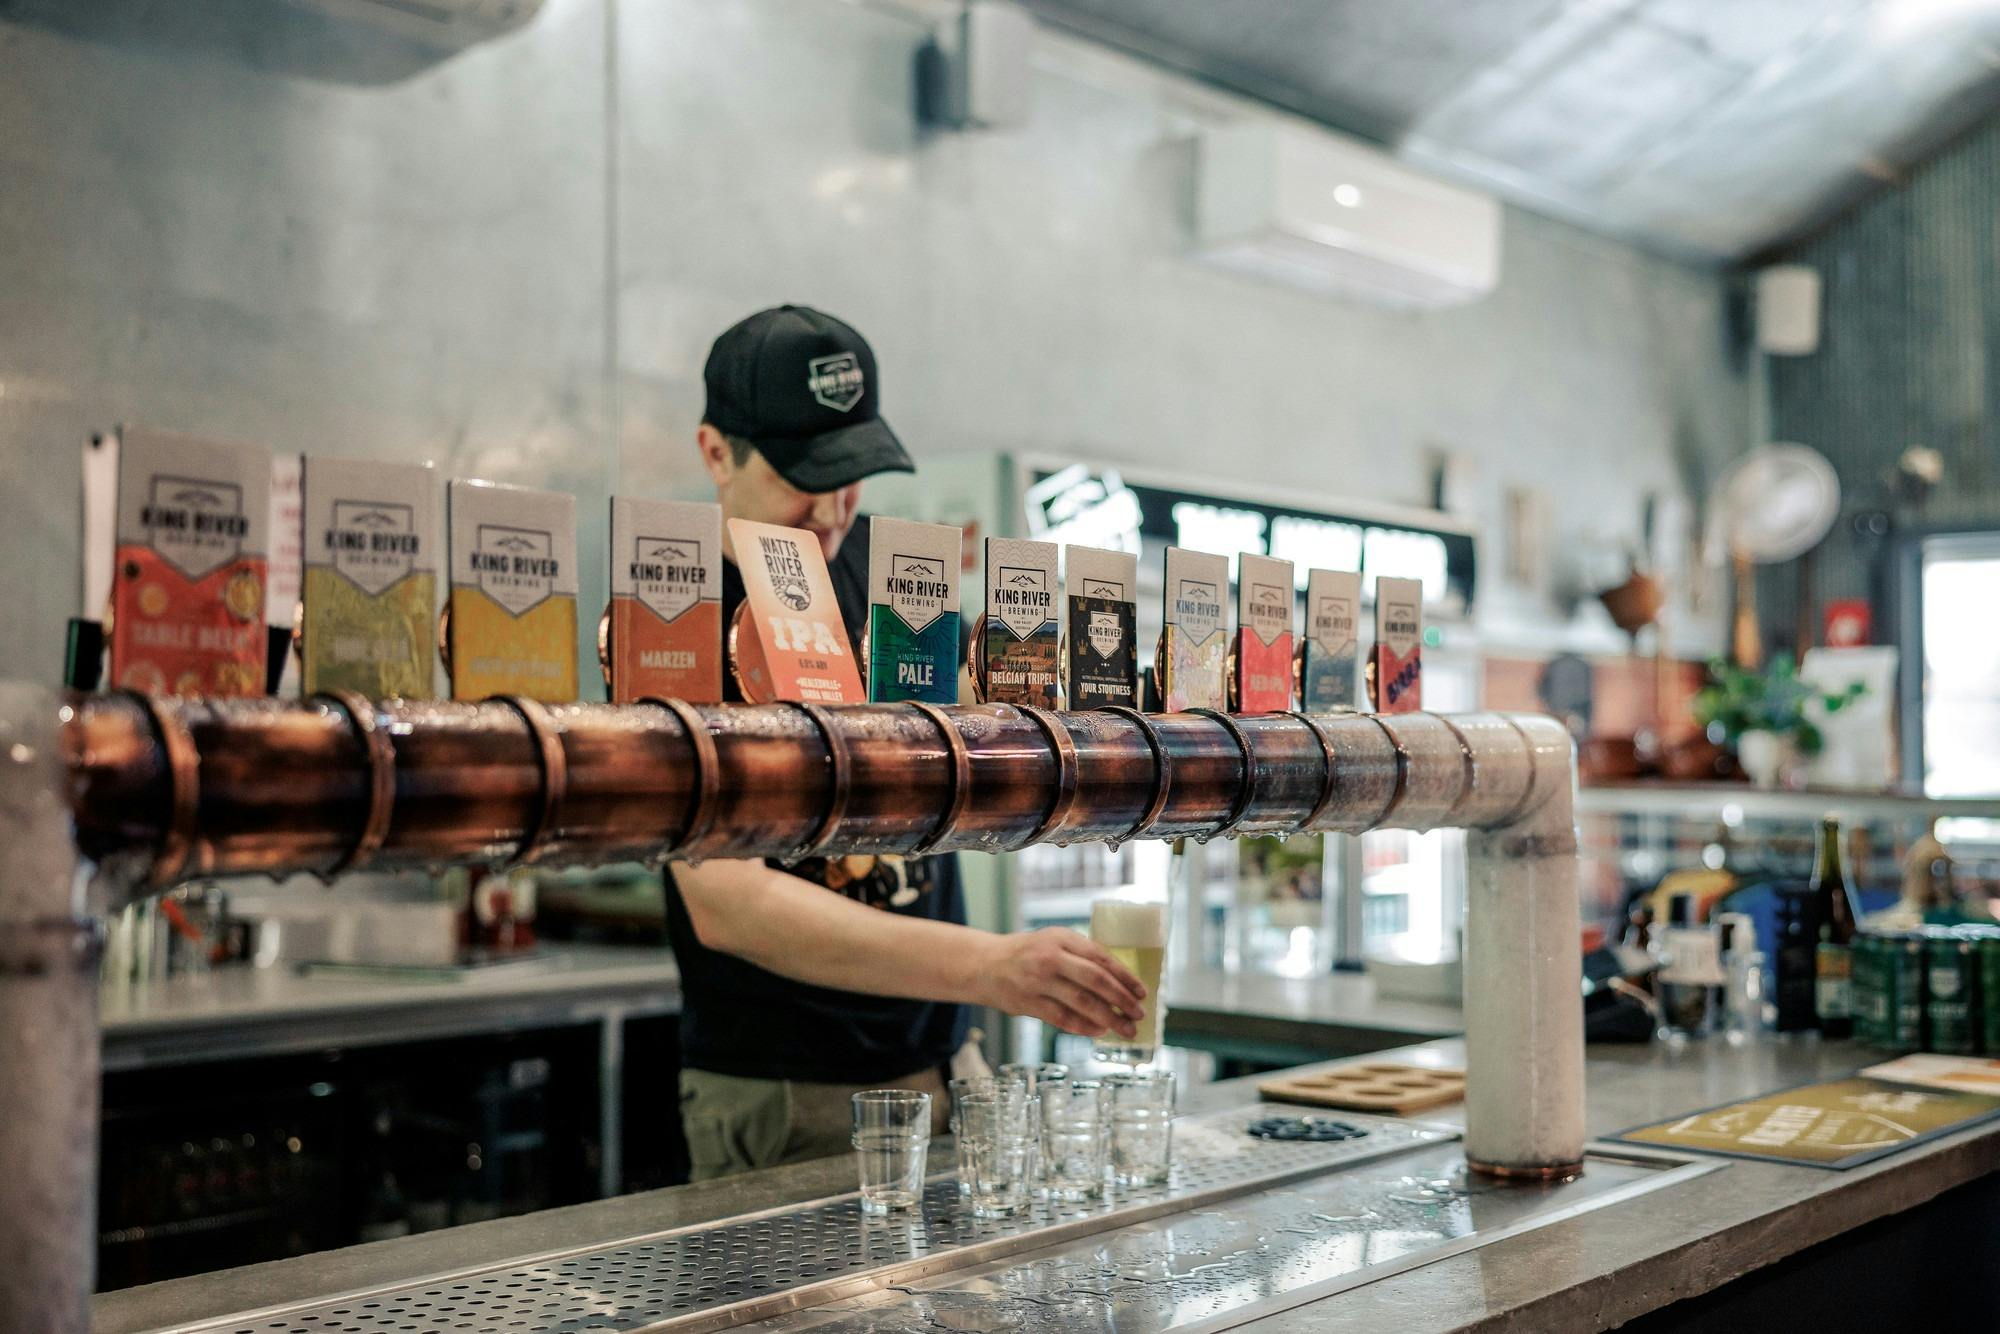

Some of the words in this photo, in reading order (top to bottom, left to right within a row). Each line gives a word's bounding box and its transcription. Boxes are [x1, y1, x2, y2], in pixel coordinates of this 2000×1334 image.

[141, 507, 188, 530] KING
[194, 511, 249, 538] RIVER
[325, 528, 367, 552] KING
[371, 532, 420, 555] RIVER
[758, 535, 800, 558] WATTS
[471, 552, 509, 573] KING
[514, 555, 558, 578] RIVER
[630, 562, 664, 582] KING
[666, 565, 707, 584] RIVER
[764, 554, 806, 578] RIVER
[648, 584, 690, 595] BREWING
[887, 577, 914, 595] KING
[916, 580, 949, 599] RIVER
[995, 588, 1019, 605] KING
[1021, 590, 1051, 607] RIVER
[901, 596, 935, 608] BREWING
[1007, 606, 1039, 617] BREWING
[1176, 599, 1196, 615] KING
[1197, 602, 1221, 618] RIVER
[1249, 602, 1266, 616] KING
[1267, 604, 1288, 620] RIVER
[768, 615, 844, 656] IPA
[1089, 625, 1103, 637] KING
[1104, 626, 1121, 638] RIVER
[640, 649, 697, 670] MARZEN
[898, 653, 914, 662] KING
[915, 654, 935, 664] RIVER
[898, 662, 934, 686] PALE
[992, 671, 1026, 684] BELGIAN
[1027, 672, 1054, 685] TRIPEL
[1080, 682, 1097, 694] YOUR
[1097, 684, 1132, 696] STOUTNESS
